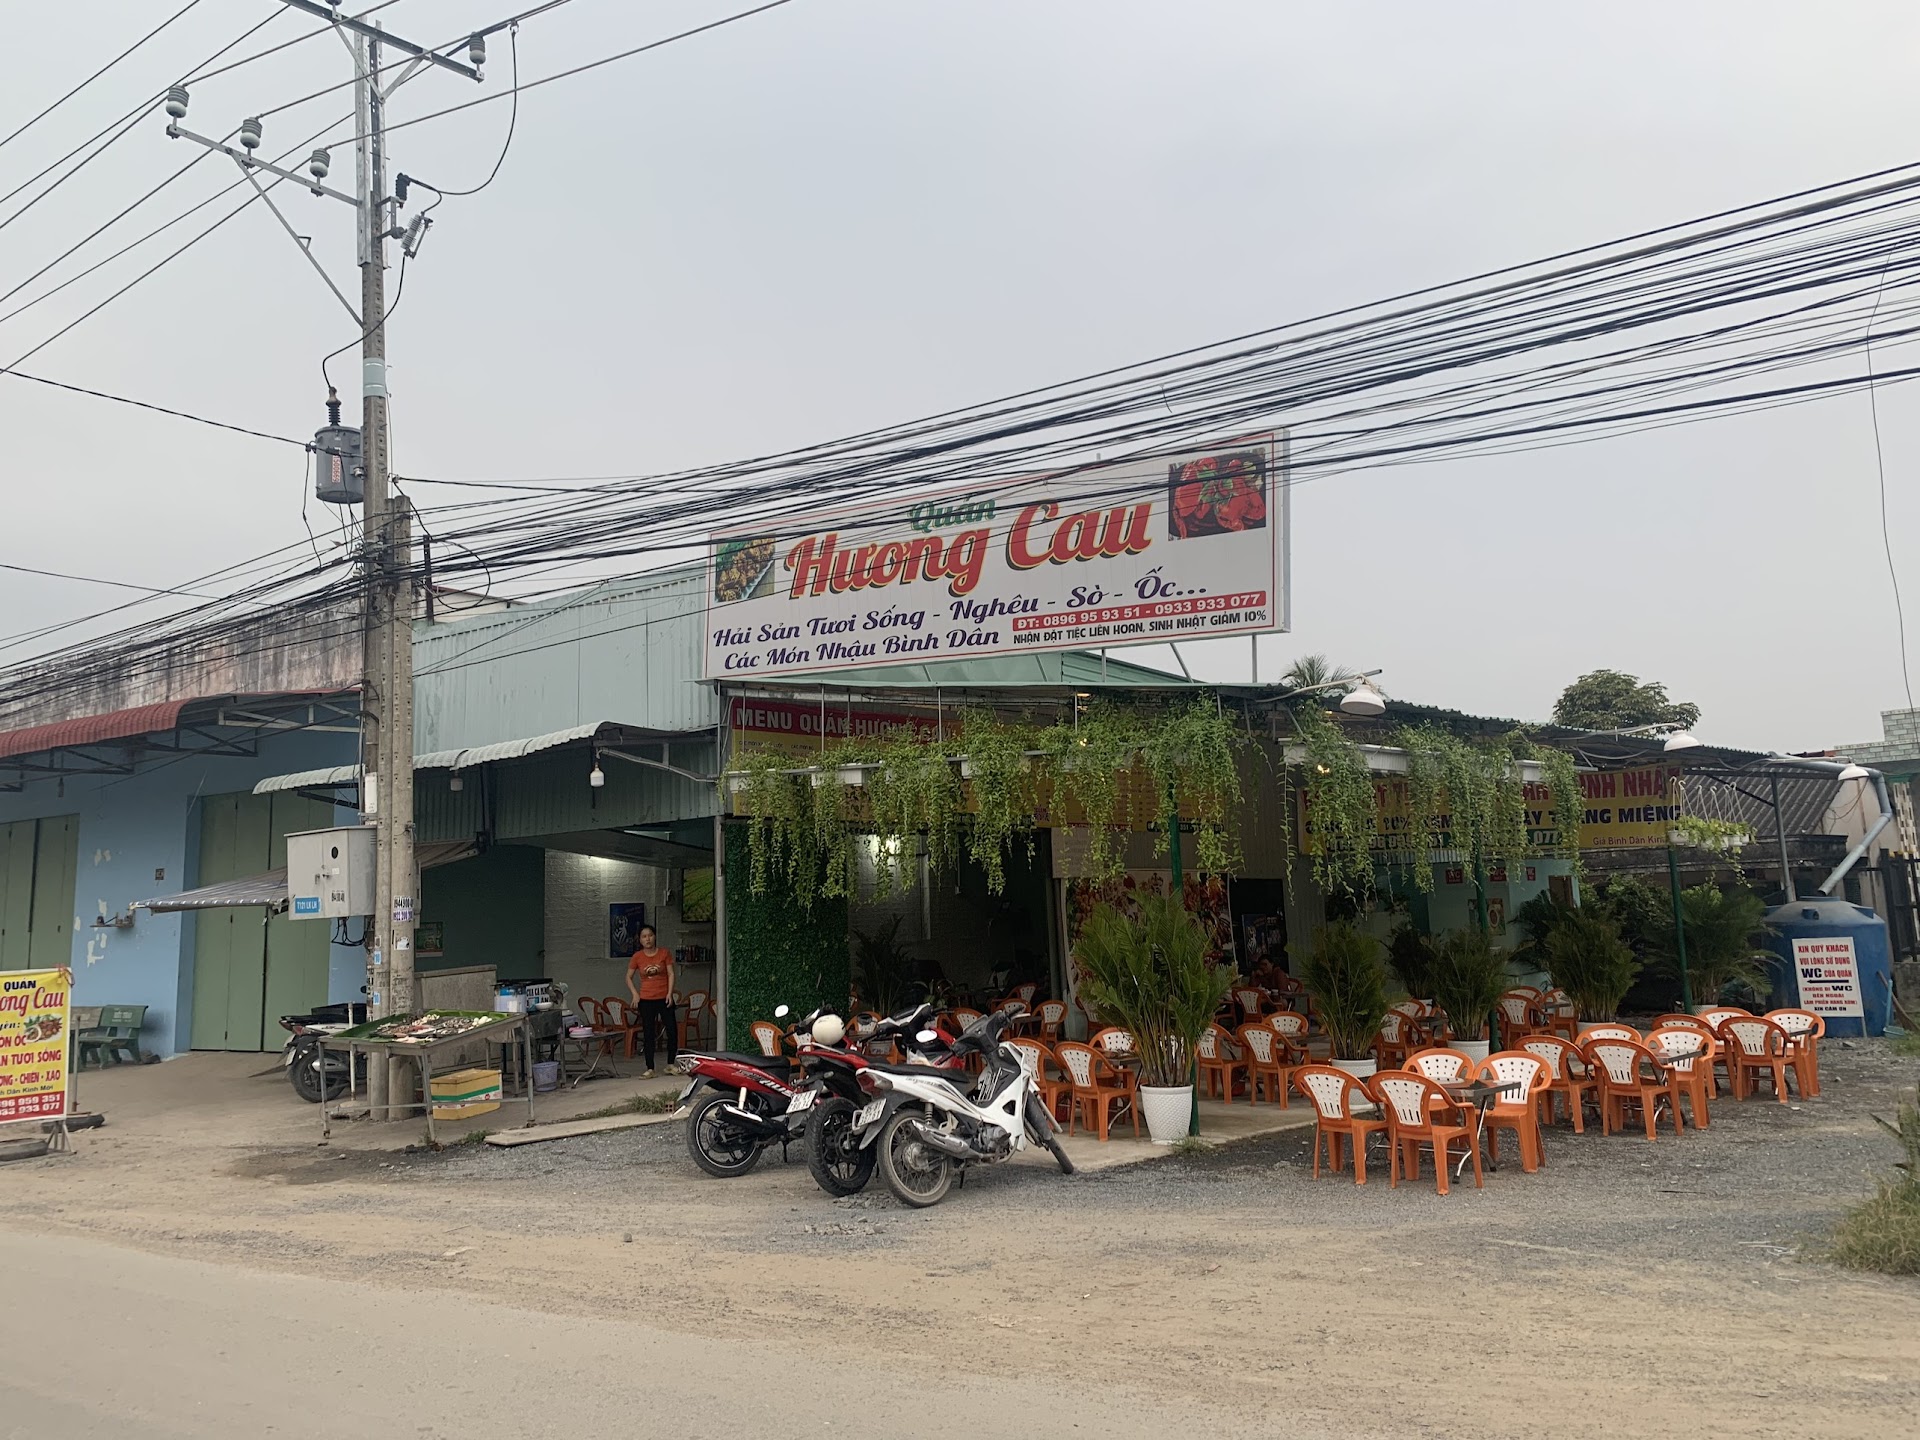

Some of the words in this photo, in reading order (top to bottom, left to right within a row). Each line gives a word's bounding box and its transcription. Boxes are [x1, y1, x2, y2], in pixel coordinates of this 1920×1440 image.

[907, 495, 996, 533] Quán
[784, 526, 991, 599] Hương
[1006, 500, 1153, 571] Cau
[713, 627, 752, 647] Hải
[757, 622, 800, 643] Sản
[807, 615, 856, 636] Tươi
[862, 605, 925, 630] Sống
[950, 594, 1039, 624] Nghêu
[1066, 584, 1109, 608] Sò
[1134, 566, 1207, 600] Ốc...
[1017, 618, 1040, 630] ĐT:
[1043, 615, 1076, 627] 0896
[1080, 612, 1098, 623] 95
[1101, 610, 1120, 621] 93
[1123, 607, 1140, 619] 51
[1155, 602, 1192, 616] 0933
[1196, 597, 1226, 610] 933
[1230, 593, 1261, 607] 077
[1043, 628, 1063, 642] ĐẶT
[1066, 626, 1086, 640] TIỆC
[1089, 623, 1110, 637] LIÊN
[1113, 622, 1146, 636] HOAN,
[1149, 620, 1173, 632] SINH
[1177, 615, 1207, 631] NHẬT
[1210, 610, 1241, 626] GIẢM
[1244, 609, 1267, 623] 10%
[724, 650, 760, 670] Các
[767, 645, 810, 666] Món
[816, 640, 876, 662] Nhậu
[882, 632, 939, 654] Bình
[946, 628, 999, 648] Dân
[736, 708, 792, 730] MENU
[800, 712, 849, 734] QUÁN
[1618, 804, 1681, 825] MIỆNG
[1533, 830, 1559, 845] 077
[1798, 945, 1809, 953] XIN
[1826, 944, 1849, 952] KHÁCH
[1799, 957, 1809, 965] VUI
[1801, 967, 1822, 978] WC
[4, 977, 36, 992] QUÁN
[33, 986, 64, 1009] Cau
[41, 1093, 60, 1103] 351
[42, 1101, 60, 1111] 077
